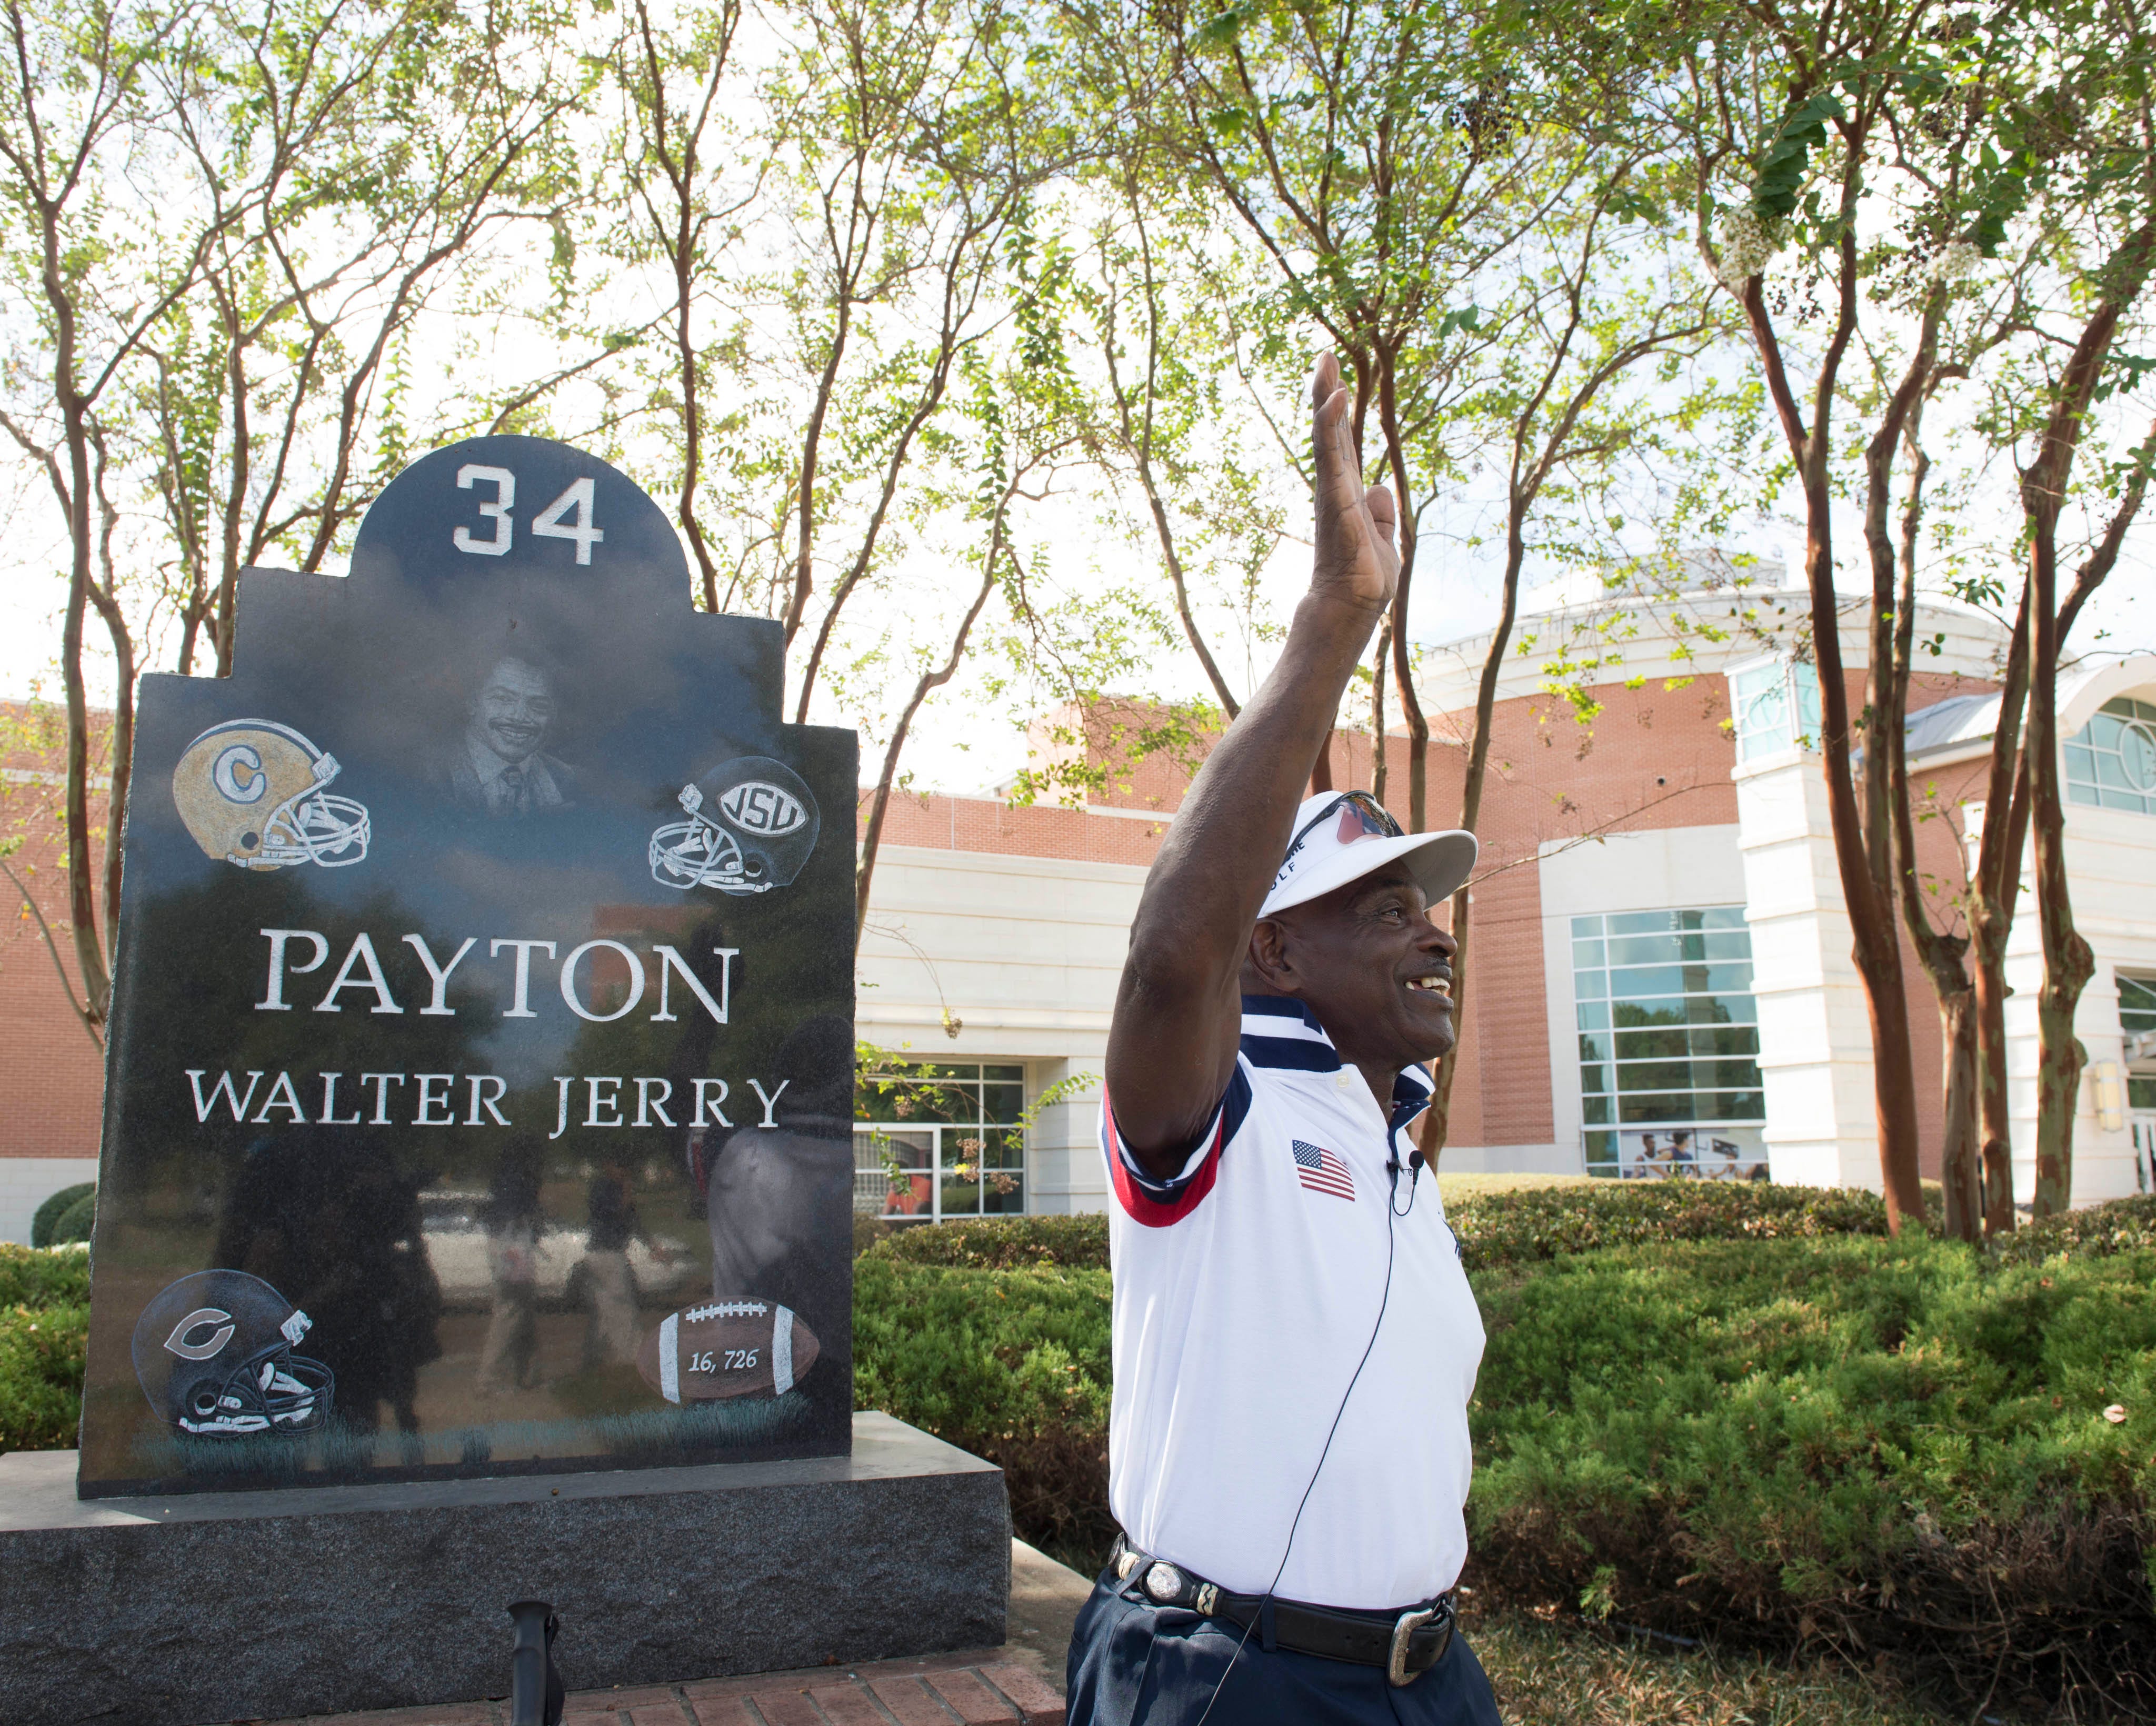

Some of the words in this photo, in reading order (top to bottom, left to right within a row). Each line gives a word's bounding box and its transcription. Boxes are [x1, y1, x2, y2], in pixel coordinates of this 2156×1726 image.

[453, 464, 604, 565] 34
[213, 745, 266, 804] C
[723, 784, 800, 831] JSU
[254, 929, 739, 1024] PAYTON
[185, 1070, 512, 1126] WALTER
[548, 1076, 790, 1139] JERRY
